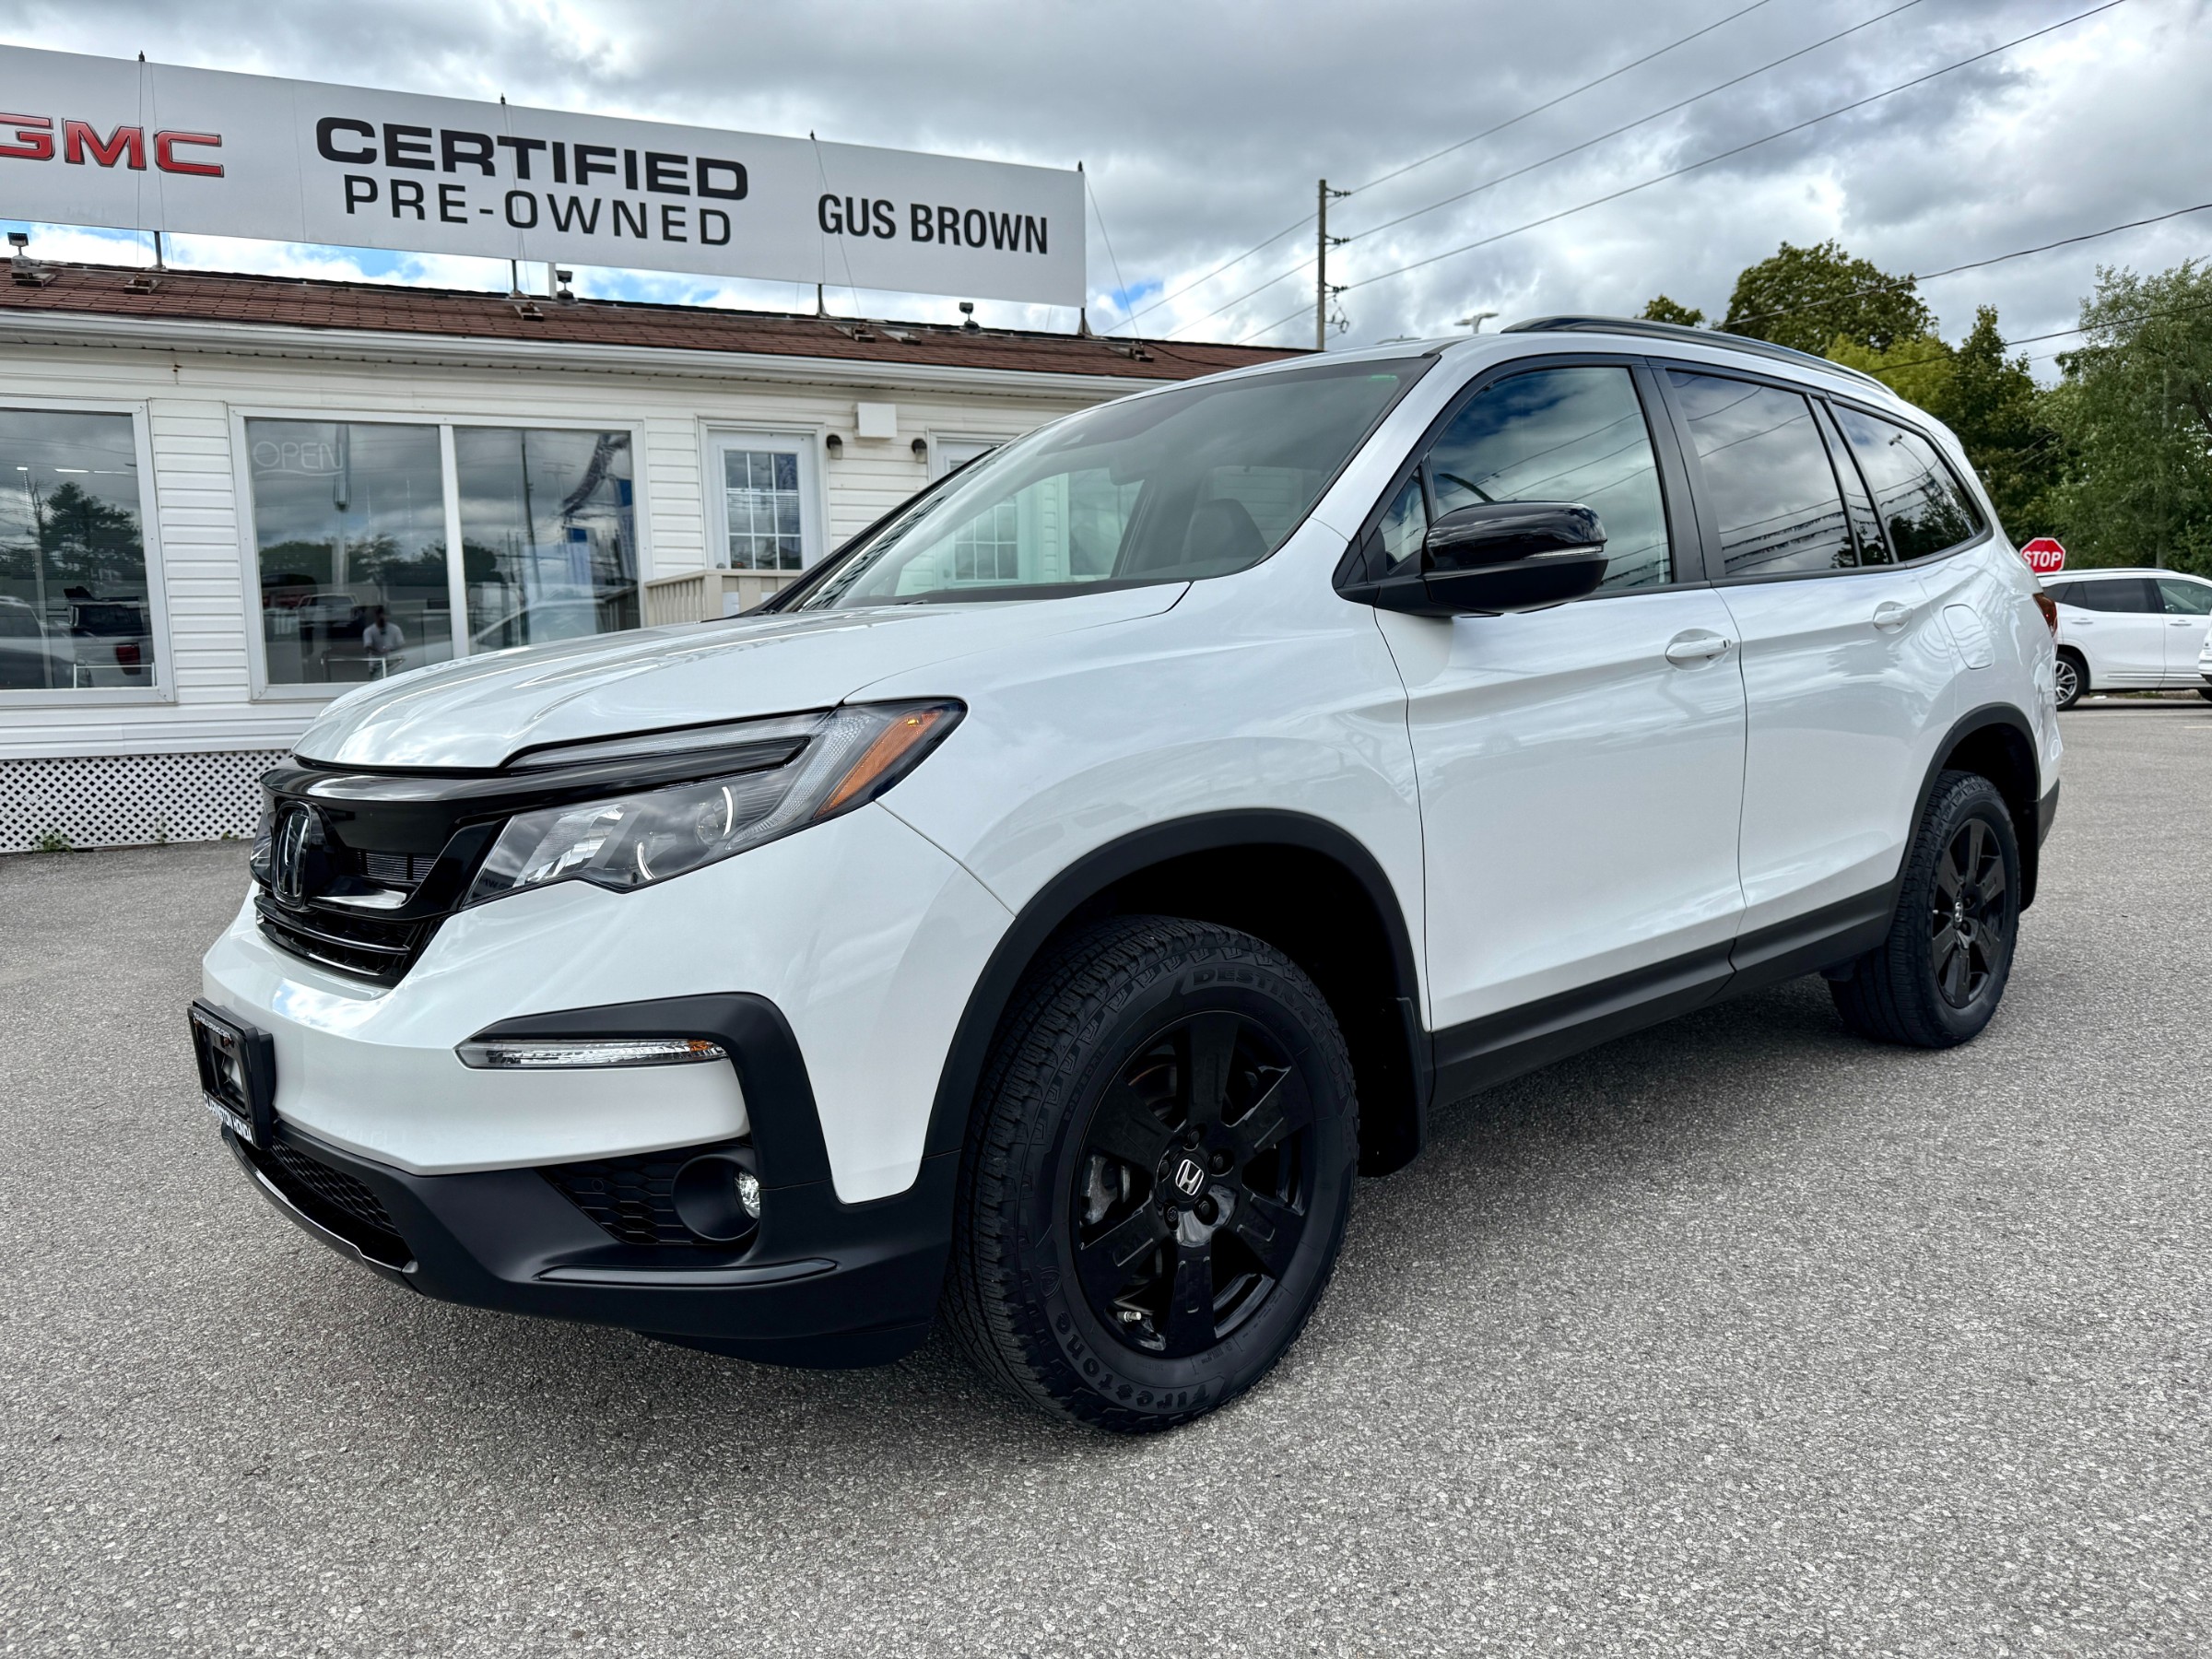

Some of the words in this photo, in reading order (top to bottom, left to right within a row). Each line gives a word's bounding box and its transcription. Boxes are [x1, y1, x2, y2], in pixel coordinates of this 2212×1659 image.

[0, 112, 224, 177] GMC
[316, 116, 748, 201] CERTIFIED
[344, 173, 732, 246] PRE-OWNED
[818, 193, 897, 240] GUS
[910, 203, 1049, 254] BROWN
[253, 441, 344, 470] OPEN
[2023, 551, 2062, 568] STOP
[1055, 1311, 1210, 1409] Firestone
